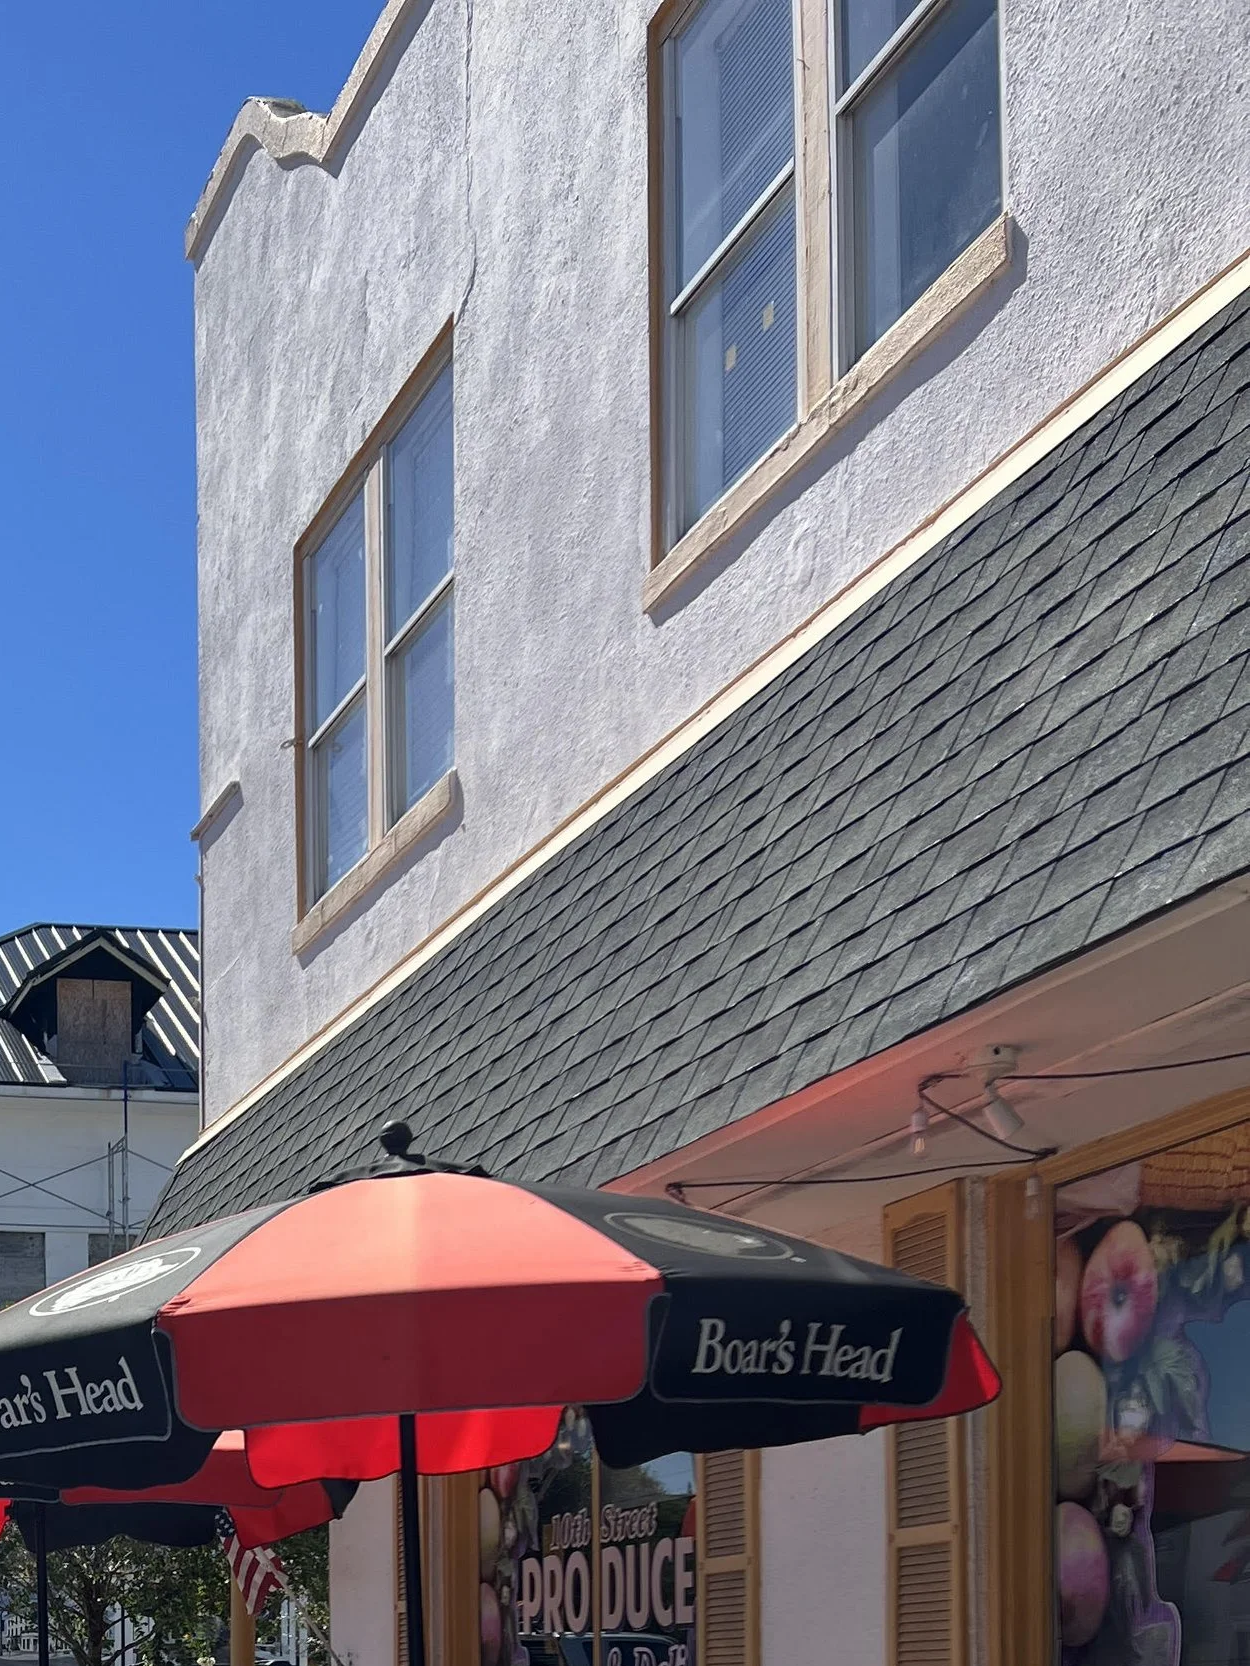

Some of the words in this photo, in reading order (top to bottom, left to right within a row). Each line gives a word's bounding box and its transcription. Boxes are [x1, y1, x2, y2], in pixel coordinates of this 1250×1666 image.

[690, 1317, 796, 1376] Boar's
[799, 1321, 905, 1385] Head
[42, 1355, 144, 1420] Head
[550, 1507, 593, 1551] 10th
[599, 1502, 659, 1544] Street
[521, 1536, 695, 1635] PRODUCE
